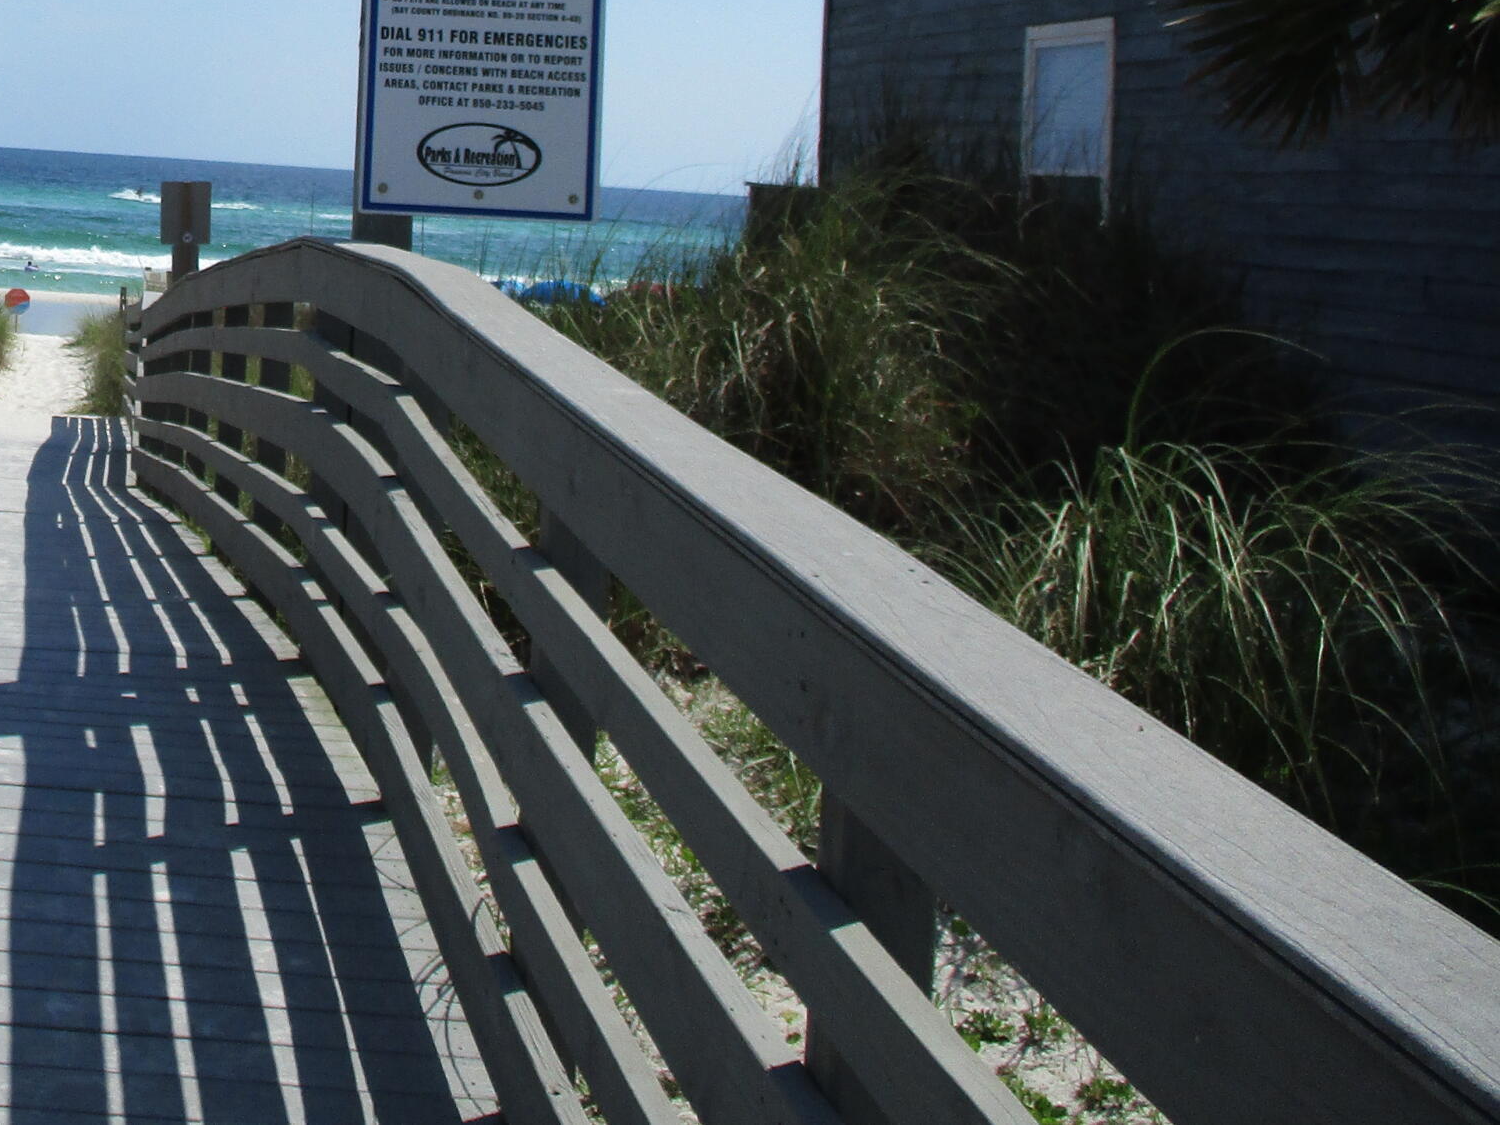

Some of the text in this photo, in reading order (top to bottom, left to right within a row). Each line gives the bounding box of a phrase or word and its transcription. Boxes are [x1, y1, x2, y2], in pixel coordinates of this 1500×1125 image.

[379, 26, 588, 50] DIAL 911 FOR EMERGENCIES
[383, 46, 583, 66] FOR MORE INFORMATION OR TO REPORT
[378, 62, 415, 74] ISSUES
[424, 64, 479, 77] CONCERNS
[480, 67, 508, 78] WITH
[510, 69, 545, 80] BEACH
[547, 71, 587, 83] ACCESS
[384, 78, 420, 91] AREAS,
[422, 80, 468, 92] CONTACT
[471, 82, 504, 94] PARKS
[518, 85, 581, 97] RECREATION
[418, 95, 454, 107] OFFICE
[456, 97, 469, 107] AT
[423, 146, 452, 164] Parks
